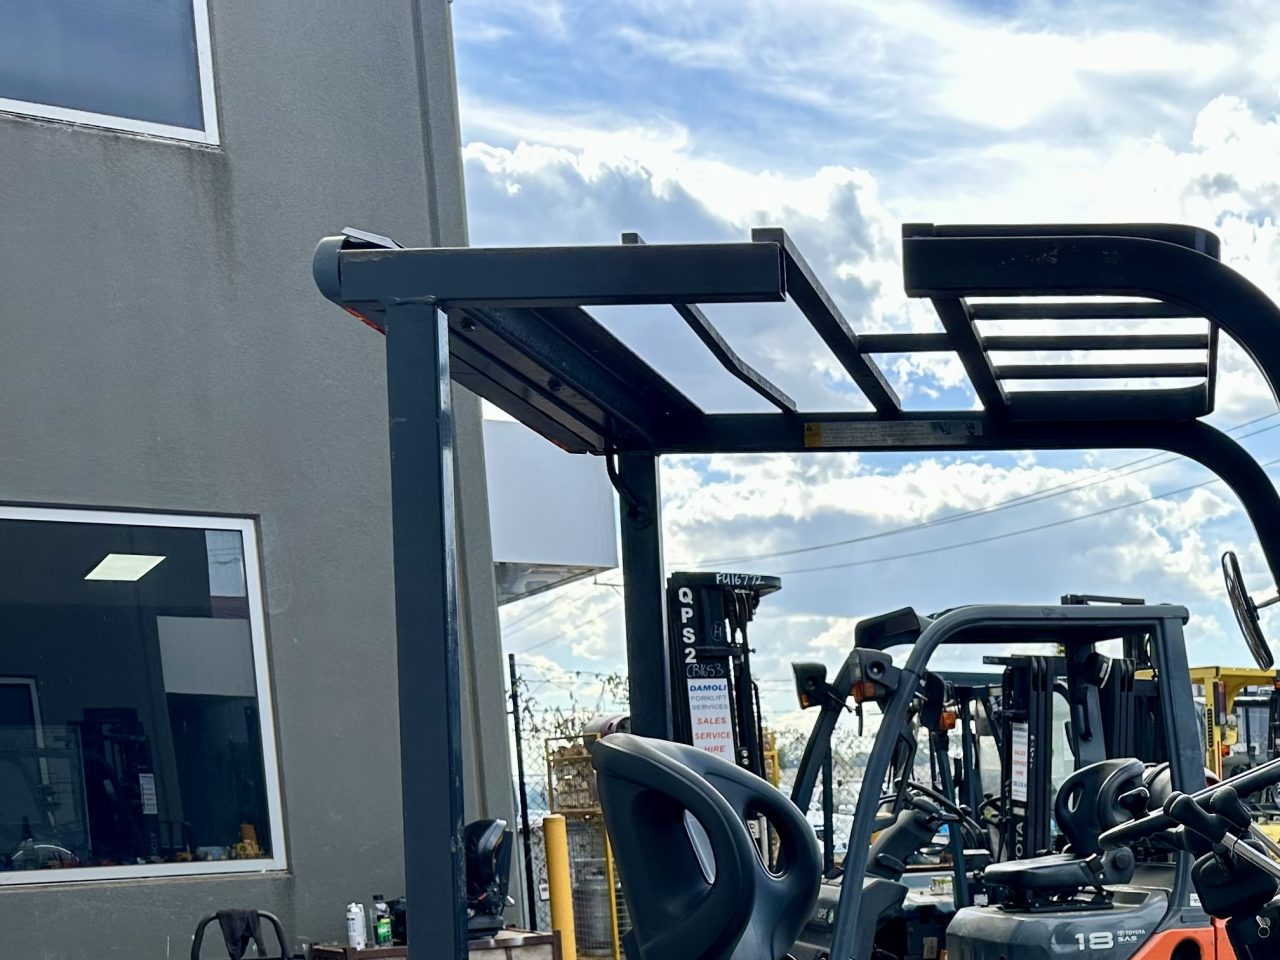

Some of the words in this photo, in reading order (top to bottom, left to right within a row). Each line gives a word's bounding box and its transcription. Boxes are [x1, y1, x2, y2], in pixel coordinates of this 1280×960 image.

[690, 684, 727, 692] DAMOLI
[692, 703, 728, 711] SERVICES
[697, 716, 726, 725] SALES
[694, 731, 731, 740] SERVICE
[704, 745, 726, 753] HIRE
[1074, 931, 1114, 951] 18
